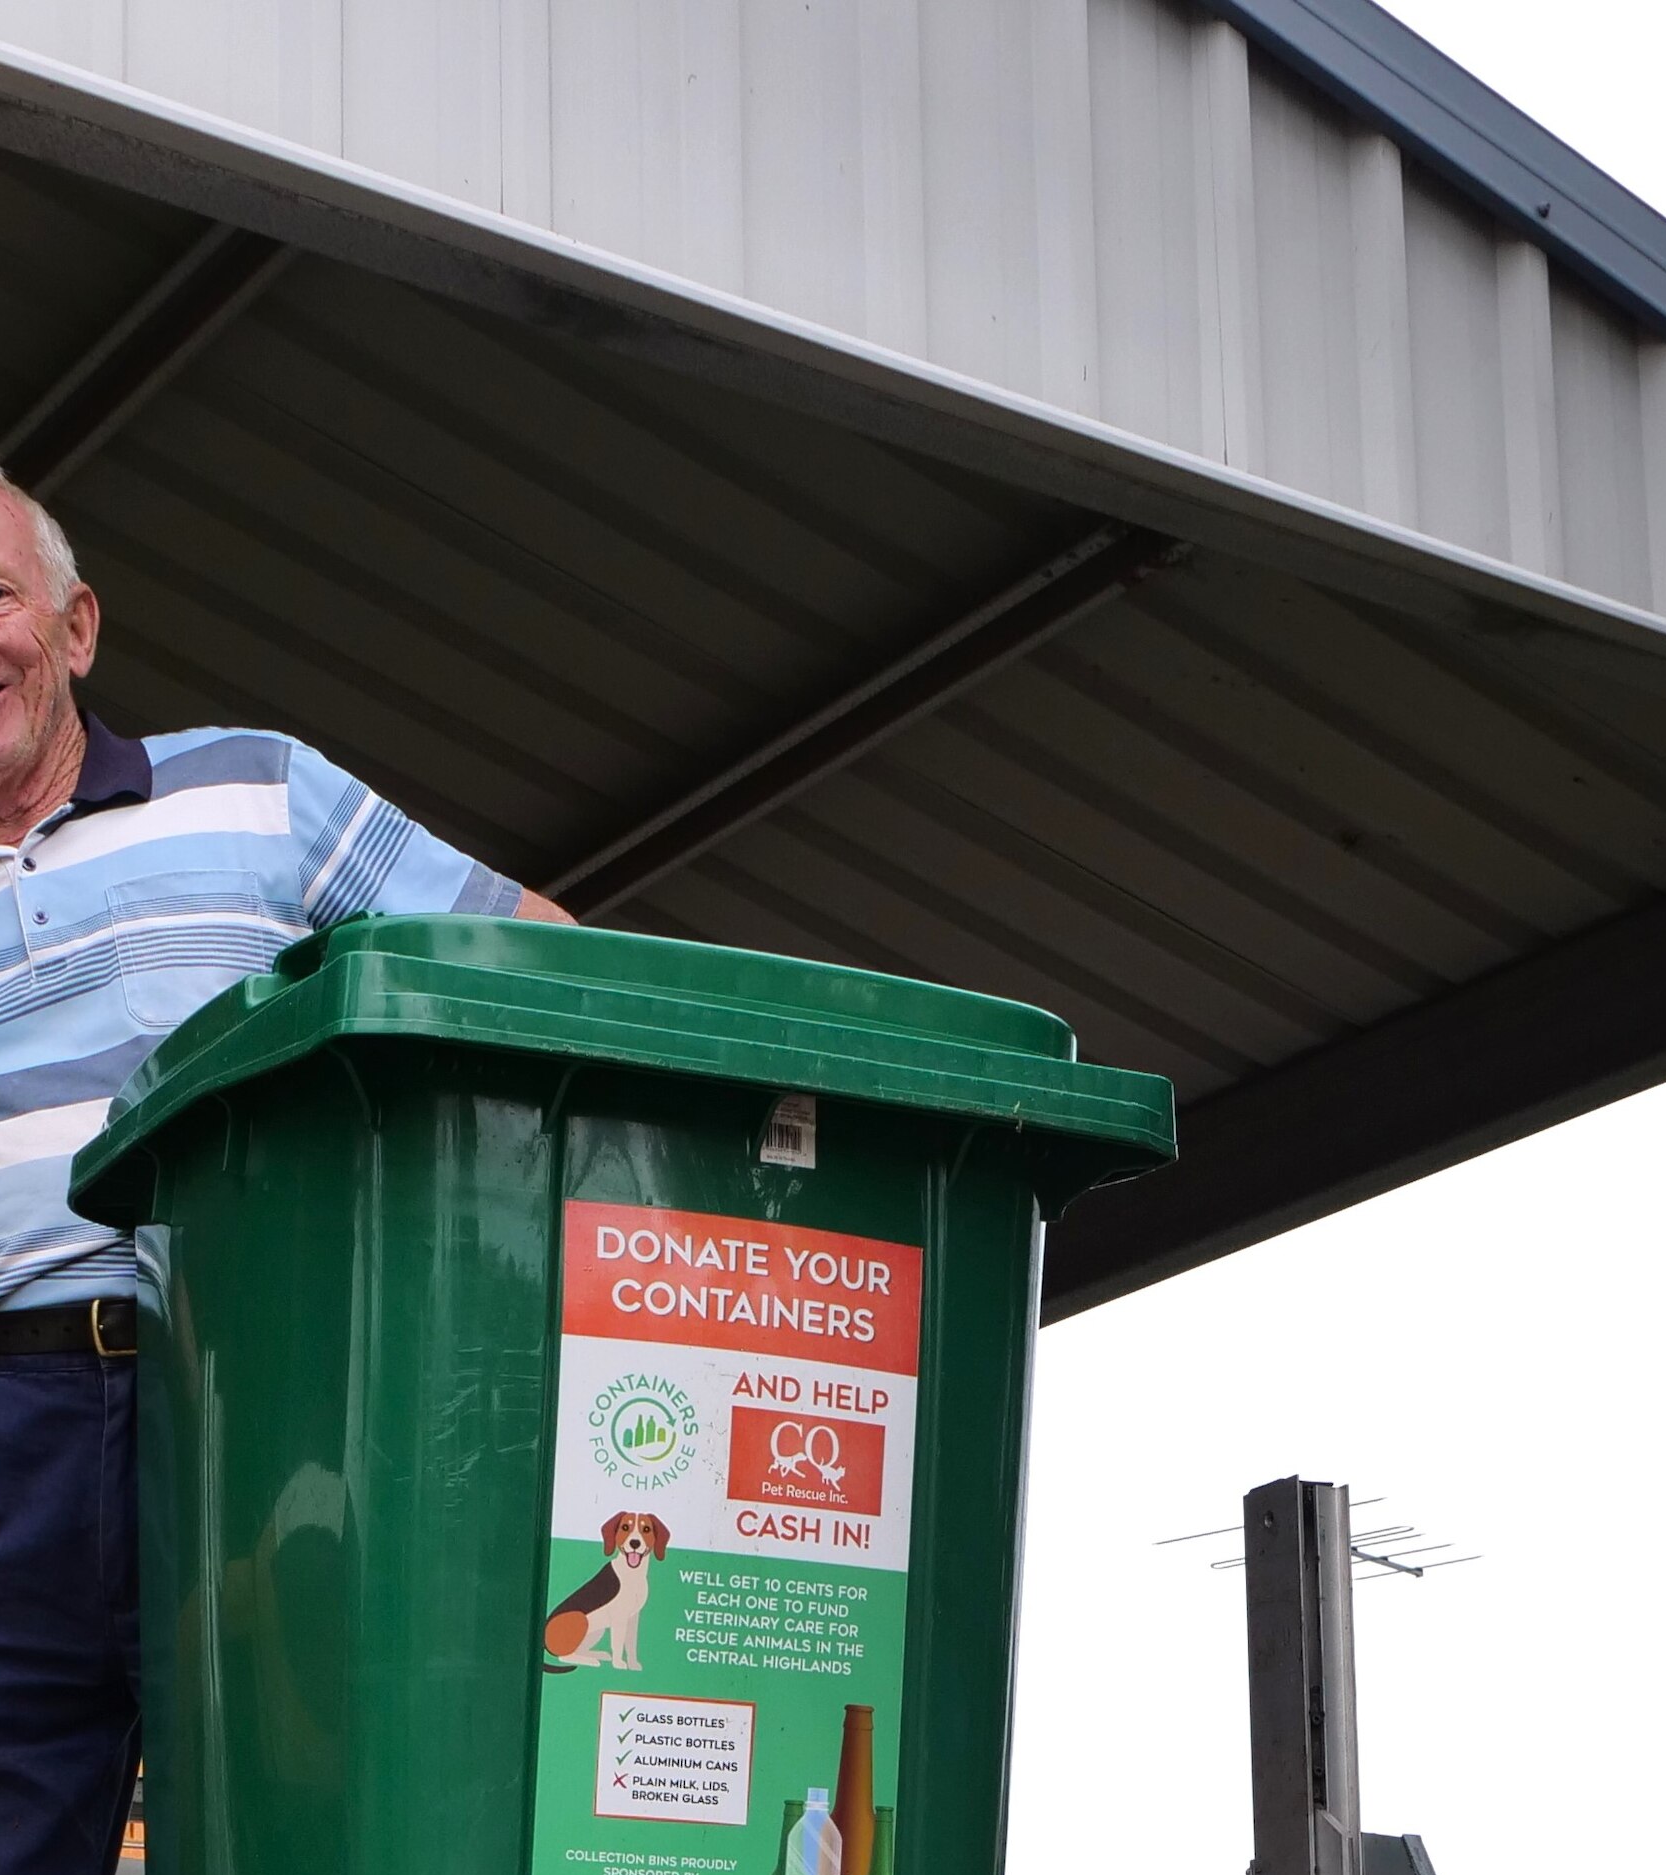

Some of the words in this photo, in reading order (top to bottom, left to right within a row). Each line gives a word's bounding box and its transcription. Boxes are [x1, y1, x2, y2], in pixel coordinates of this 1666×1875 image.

[597, 1226, 769, 1276] DONATE
[784, 1246, 891, 1295] YOUR
[611, 1279, 875, 1342] CONTAINERS
[589, 1373, 699, 1436] CONTAINERS
[732, 1371, 802, 1403] AND
[813, 1380, 889, 1415] HELP
[588, 1436, 618, 1477] FOR
[621, 1444, 696, 1491] CHANGE
[769, 1420, 845, 1478] CQ
[761, 1481, 784, 1496] Pet
[786, 1484, 827, 1501] Rescue
[829, 1490, 849, 1504] Inc.
[736, 1510, 821, 1543] CASH
[833, 1520, 871, 1549] IN!
[679, 1570, 724, 1587] WE'LL
[729, 1575, 760, 1590] GET
[764, 1578, 781, 1592] 10
[785, 1580, 834, 1598] CENTS
[838, 1586, 868, 1601] FOR
[697, 1591, 740, 1608] EACH
[745, 1596, 778, 1611] ONE
[783, 1599, 804, 1613] TO
[808, 1602, 849, 1618] FUND
[684, 1609, 780, 1630] VETERINARY
[784, 1618, 824, 1635] CARE
[829, 1622, 859, 1638] FOR
[675, 1628, 739, 1646] RESCUE
[743, 1634, 811, 1653] ANIMALS
[816, 1640, 831, 1654] IN
[836, 1642, 864, 1657] THE
[686, 1648, 758, 1667] CENTRAL
[763, 1655, 852, 1675] HIGHLANDS
[636, 1713, 674, 1725] GLASS
[677, 1716, 725, 1729] BOTTLES
[635, 1734, 682, 1747] PLASTIC
[686, 1738, 735, 1751] BOTTLES
[634, 1756, 702, 1769] ALUMINIUM
[706, 1760, 738, 1772] CANS
[631, 1790, 679, 1802] BROKEN
[682, 1794, 719, 1805] GLASS
[633, 1776, 666, 1787] PLAIN
[670, 1779, 699, 1791] MILK,
[702, 1782, 730, 1793] LIDS,
[565, 1849, 645, 1864] COLLECTION
[648, 1855, 677, 1867] BINS
[681, 1857, 738, 1871] PROUDLY
